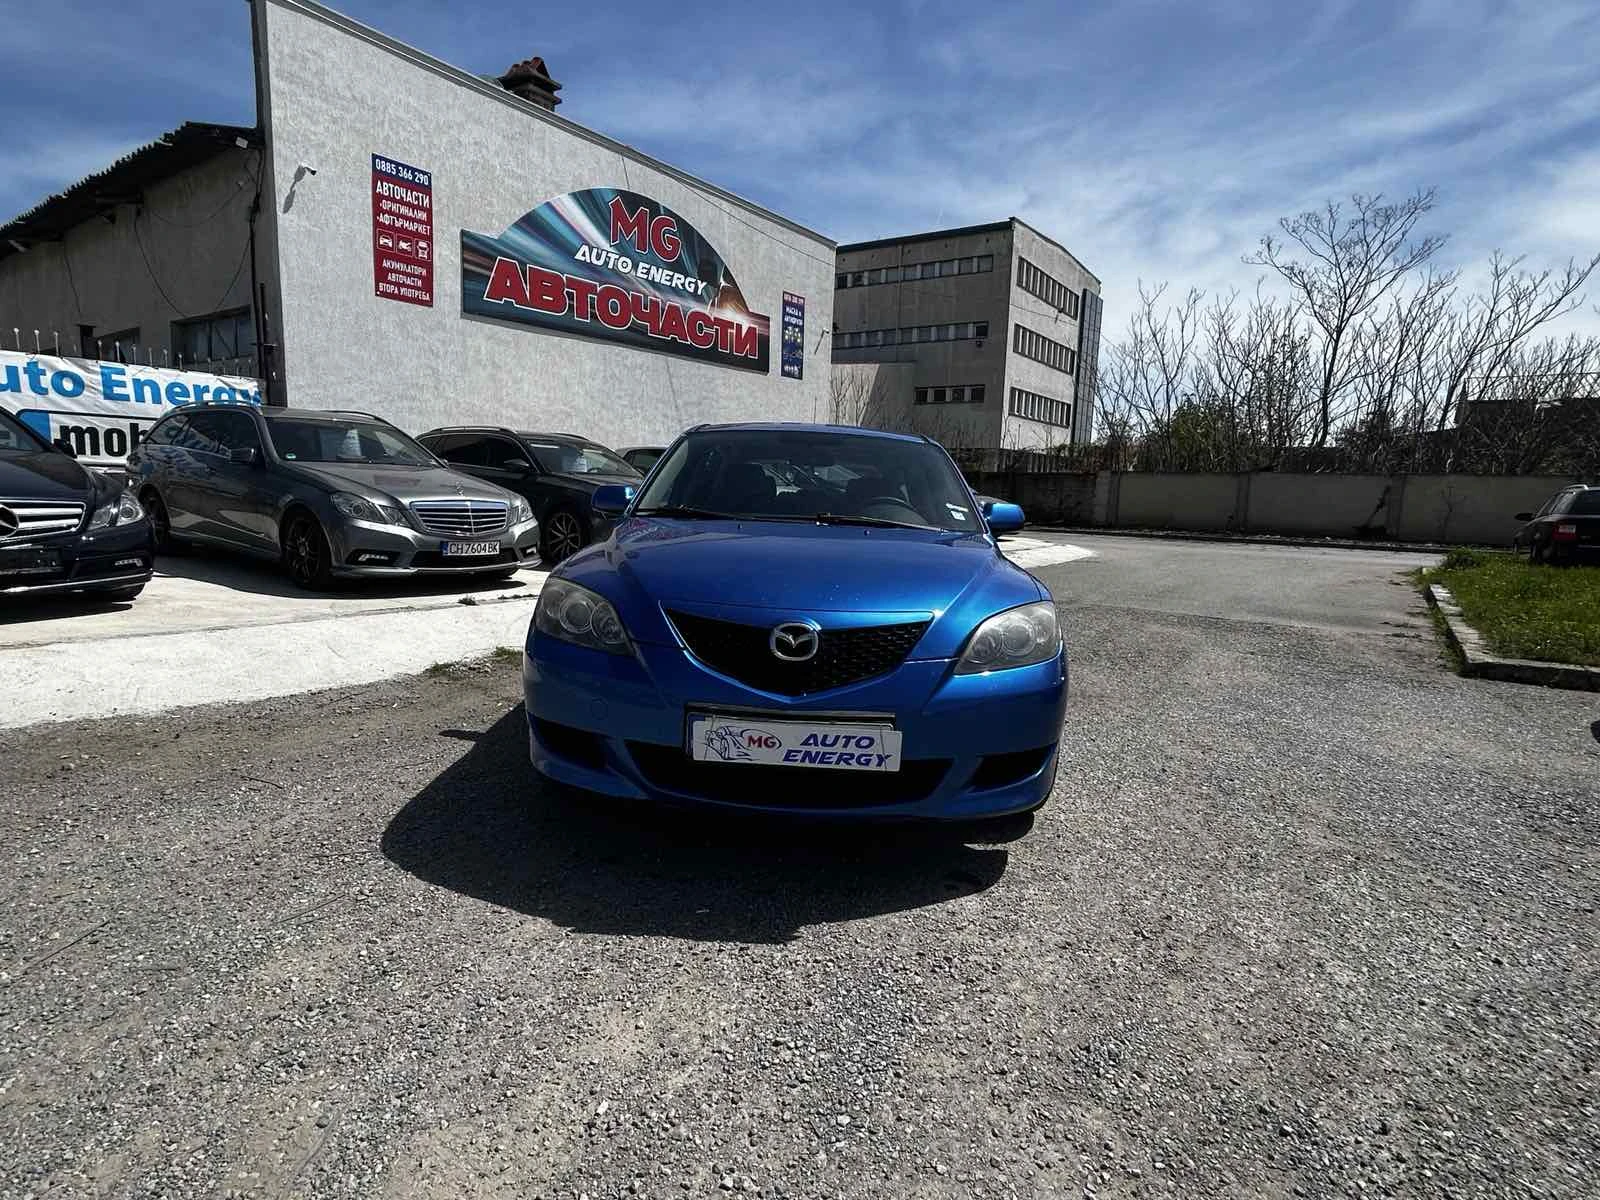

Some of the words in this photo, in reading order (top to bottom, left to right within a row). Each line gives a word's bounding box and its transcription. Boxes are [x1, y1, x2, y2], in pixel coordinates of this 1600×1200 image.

[375, 158, 397, 175] 0885
[398, 166, 413, 180] 366
[414, 172, 429, 185] 290
[376, 180, 430, 209] АВТОЧАСТИ
[608, 195, 681, 262] MG
[383, 259, 427, 277] АКУМУЛАТОРИ
[574, 244, 632, 273] AUTO
[636, 262, 707, 296] ENERGY
[387, 272, 422, 287] АВТОЧАСТИ
[378, 282, 399, 295] ВТОРА
[400, 287, 431, 301] УПОТРЕБА
[483, 256, 759, 360] АВТОЧАСТИ
[747, 735, 777, 748] MG
[800, 733, 875, 749] AUTO
[783, 750, 892, 768] ENERGY
